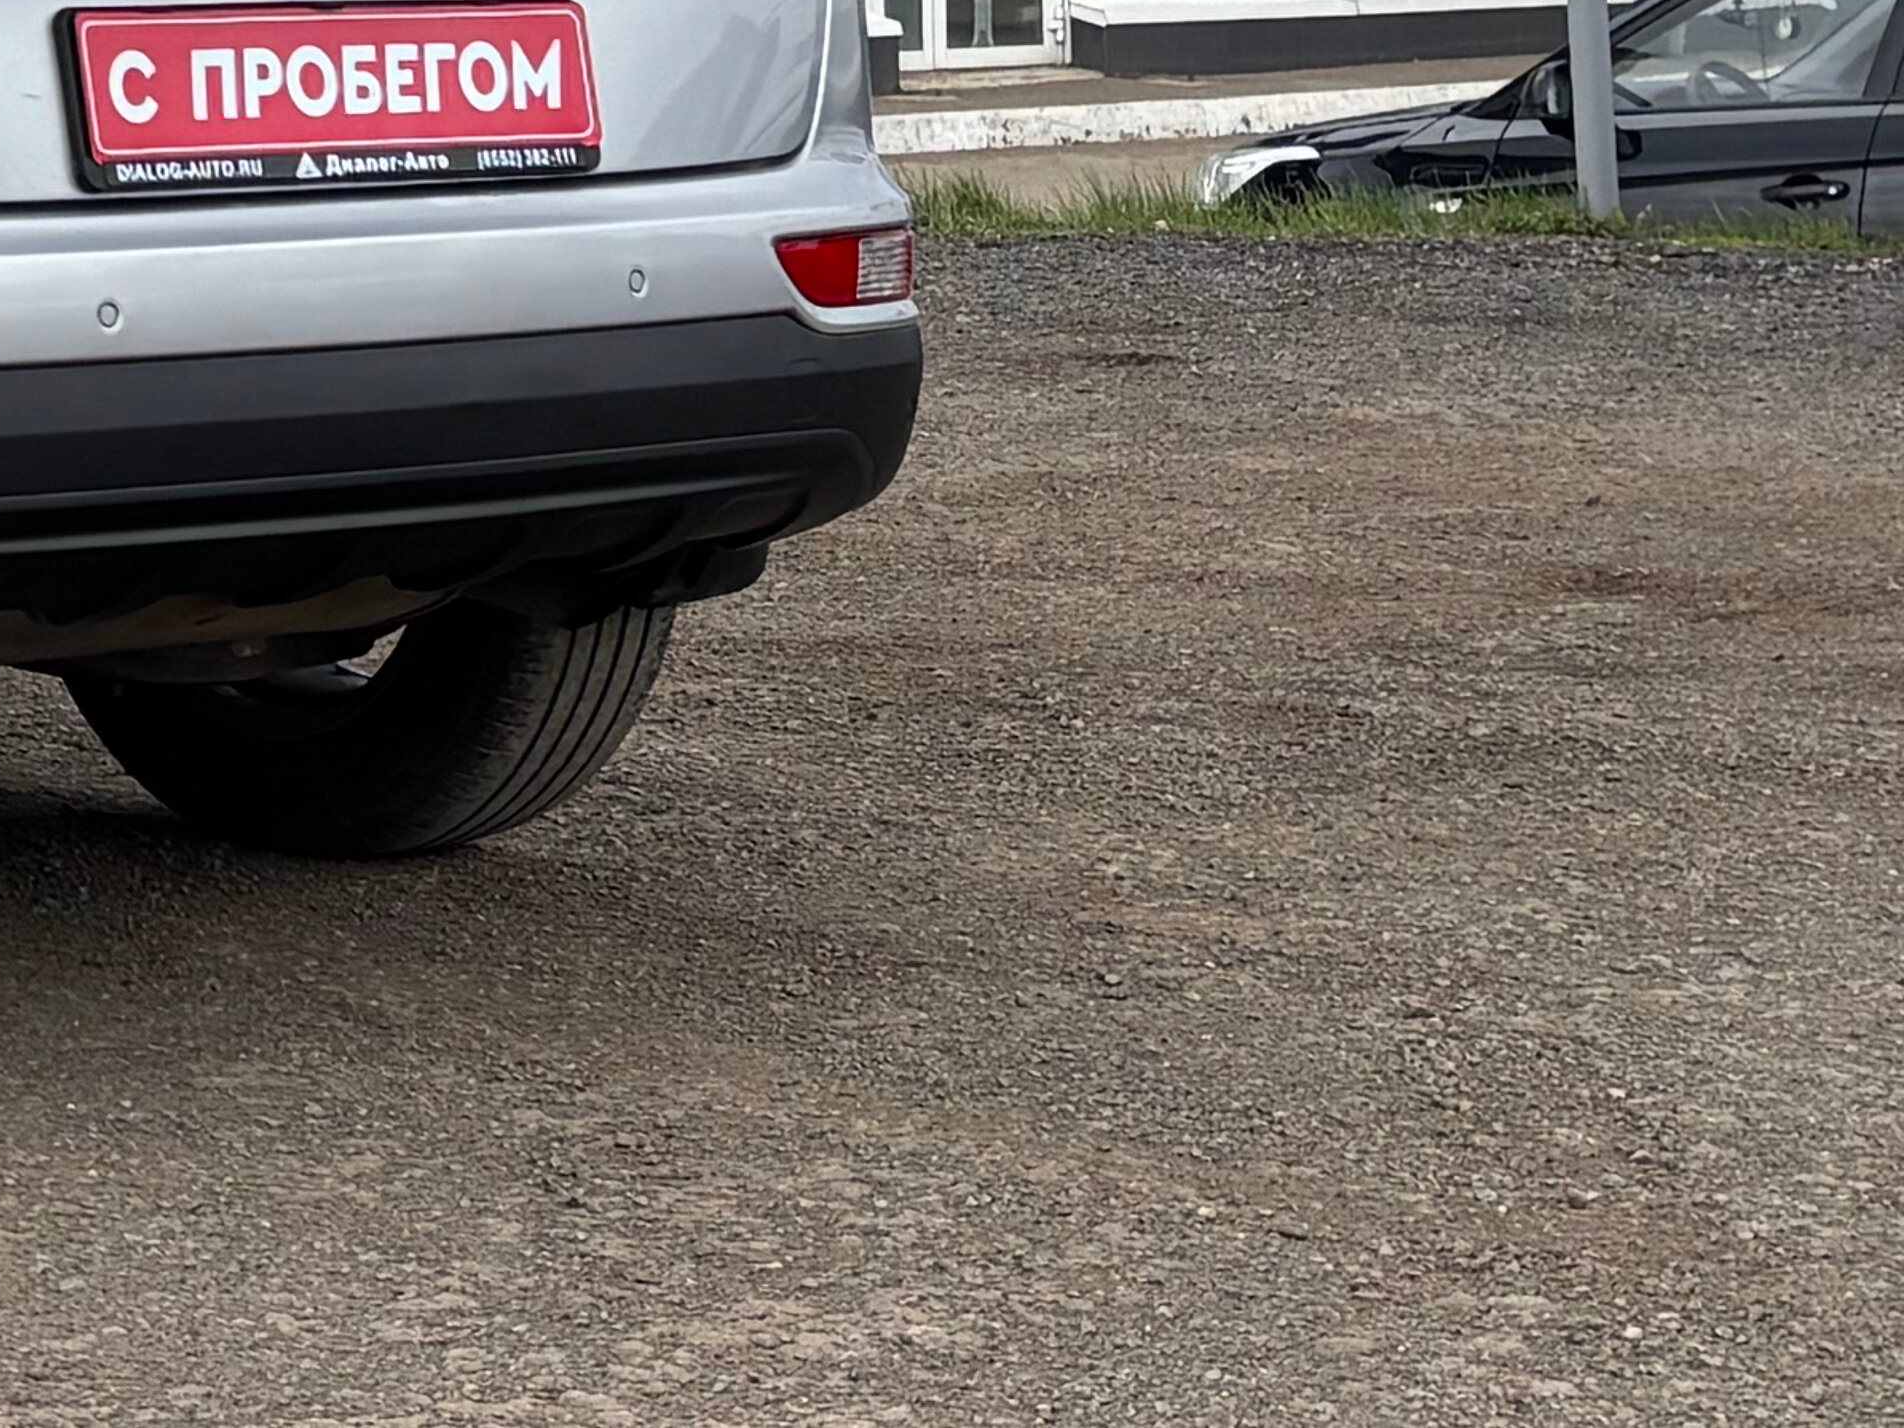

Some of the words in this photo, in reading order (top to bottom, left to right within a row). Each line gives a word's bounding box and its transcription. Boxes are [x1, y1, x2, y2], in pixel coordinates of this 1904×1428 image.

[108, 49, 160, 125] С
[190, 38, 562, 122] ПРОБЕГОМ
[115, 157, 264, 182] DIALOG-AUTO.RU
[325, 151, 451, 178] Диалог-Авто
